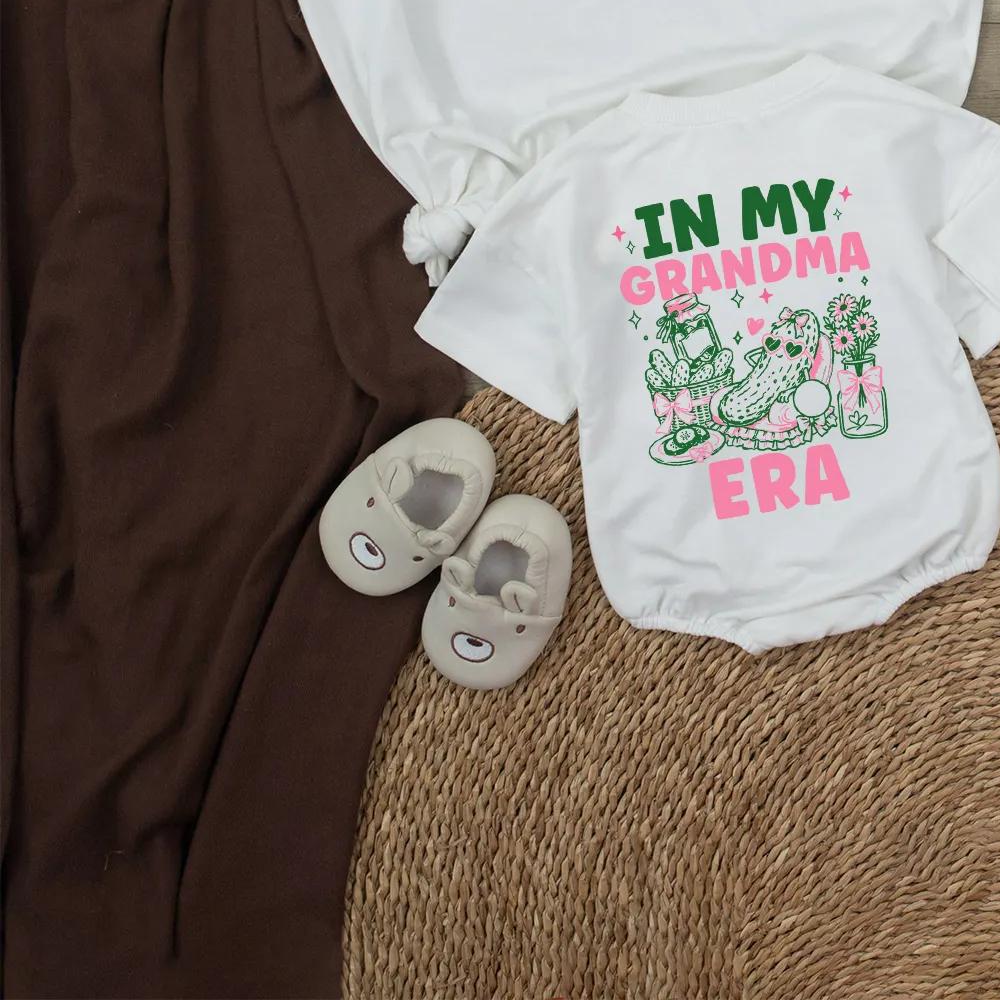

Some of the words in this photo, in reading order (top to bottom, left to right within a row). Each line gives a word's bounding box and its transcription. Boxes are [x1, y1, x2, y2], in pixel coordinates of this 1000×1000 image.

[635, 194, 720, 259] IN
[741, 178, 834, 241] MY
[620, 232, 870, 305] GRANDMA
[708, 444, 850, 520] ERA
